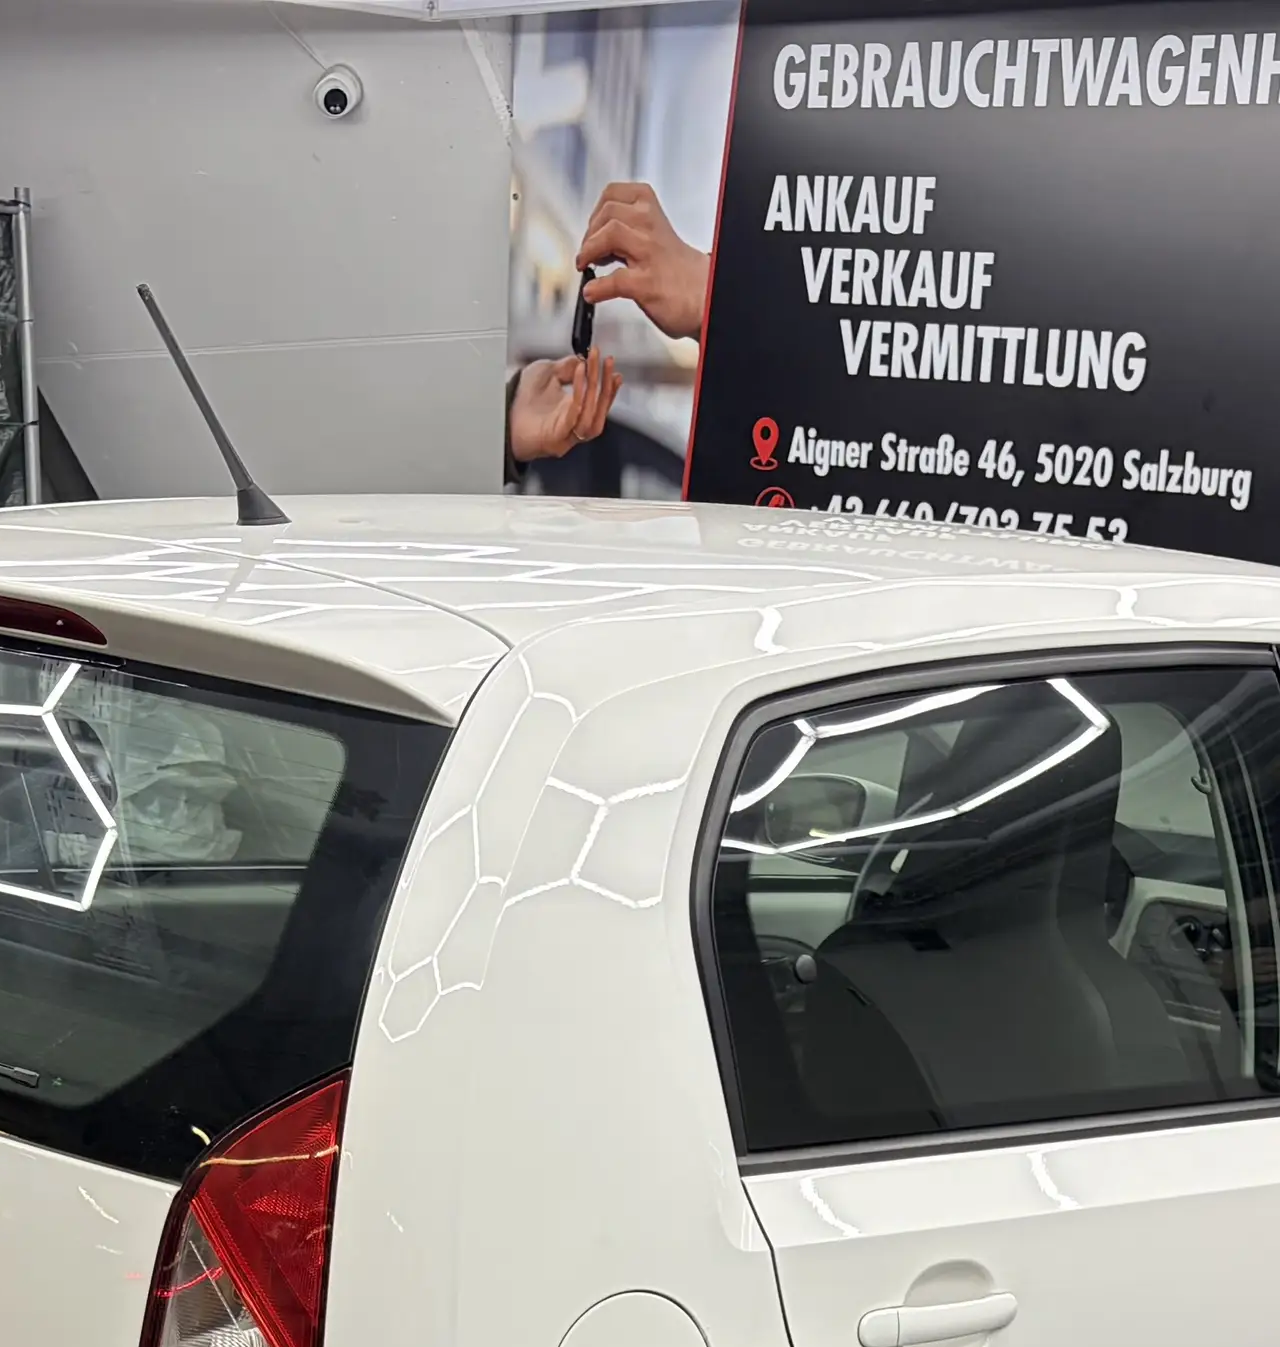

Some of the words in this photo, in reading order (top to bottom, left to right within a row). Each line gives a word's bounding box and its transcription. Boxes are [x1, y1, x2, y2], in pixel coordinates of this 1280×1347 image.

[763, 174, 937, 235] ANKAUF
[800, 246, 995, 310] VERKAUF
[839, 318, 1147, 392] VERMITTLUNG
[787, 425, 873, 477] Aigner
[880, 431, 970, 476] Straße
[977, 438, 1025, 488] 46,
[1034, 443, 1114, 488] 5020
[1122, 448, 1253, 512] Salzburg
